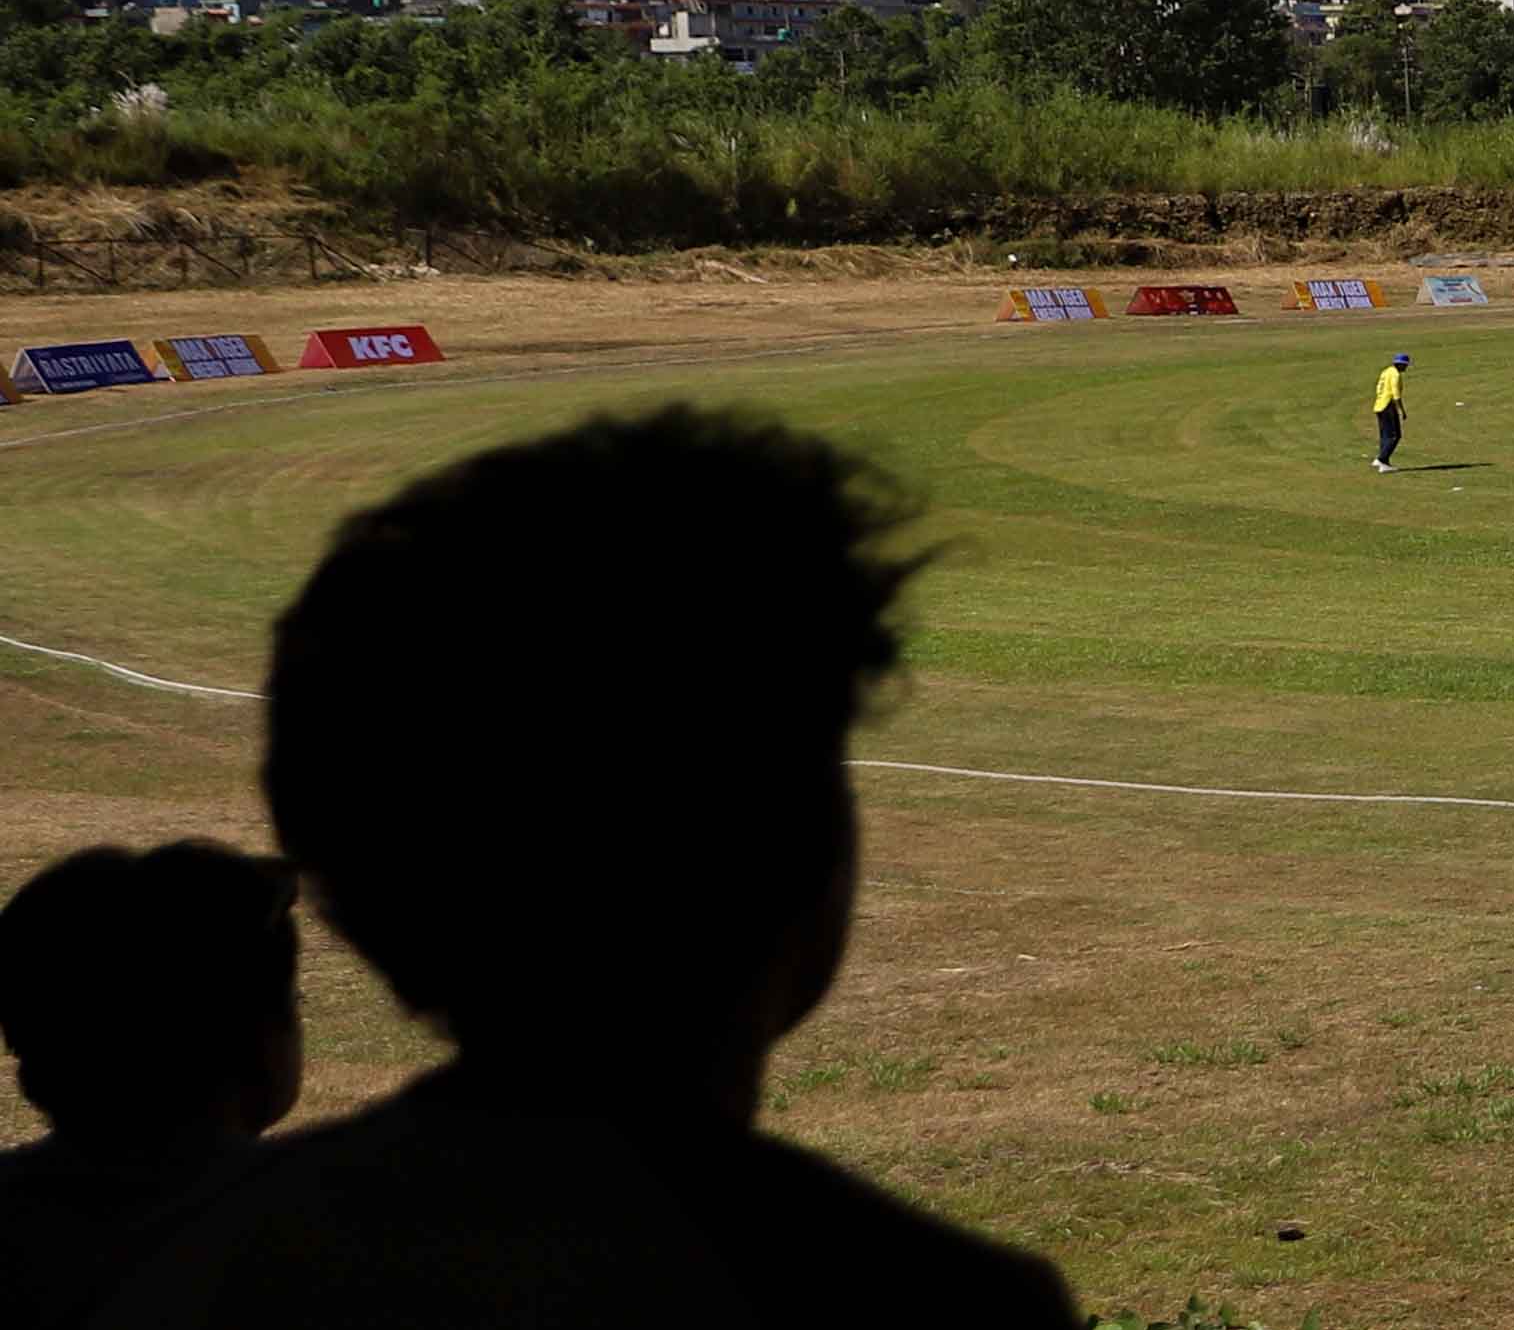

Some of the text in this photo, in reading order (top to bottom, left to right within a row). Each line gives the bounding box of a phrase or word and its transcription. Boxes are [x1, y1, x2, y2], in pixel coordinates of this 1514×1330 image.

[1024, 289, 1060, 306] MAX
[1308, 281, 1368, 296] MAX TIGER
[172, 335, 253, 360] MAX TIGER
[348, 334, 414, 360] KFC
[38, 351, 141, 378] RASTRIYATA
